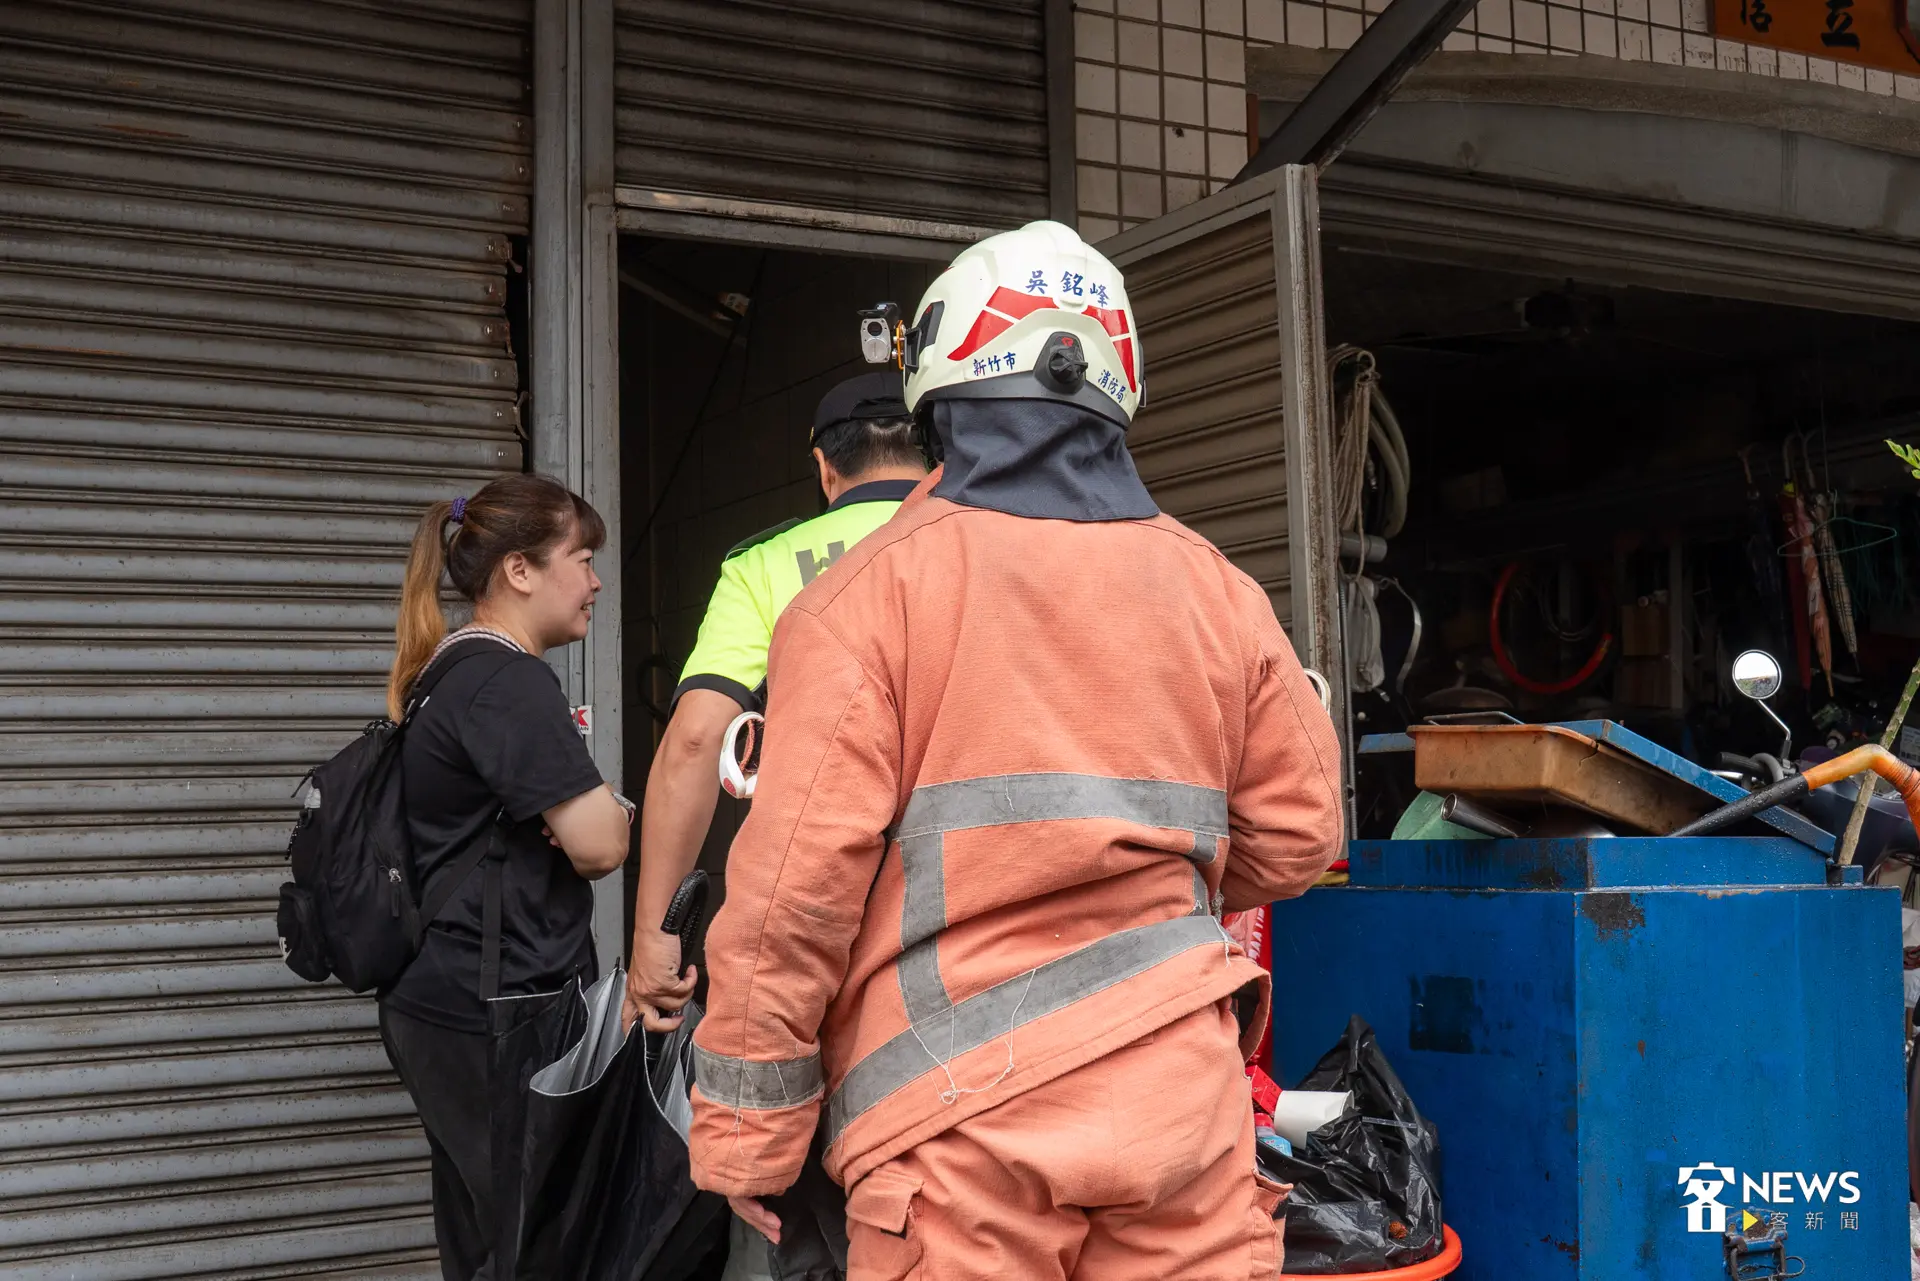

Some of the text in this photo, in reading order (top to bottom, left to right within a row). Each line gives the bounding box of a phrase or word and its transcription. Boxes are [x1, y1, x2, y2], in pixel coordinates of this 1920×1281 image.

[1025, 270, 1110, 308] 吳銘峰
[972, 351, 1017, 377] 新竹市
[1097, 369, 1127, 403] 消防局
